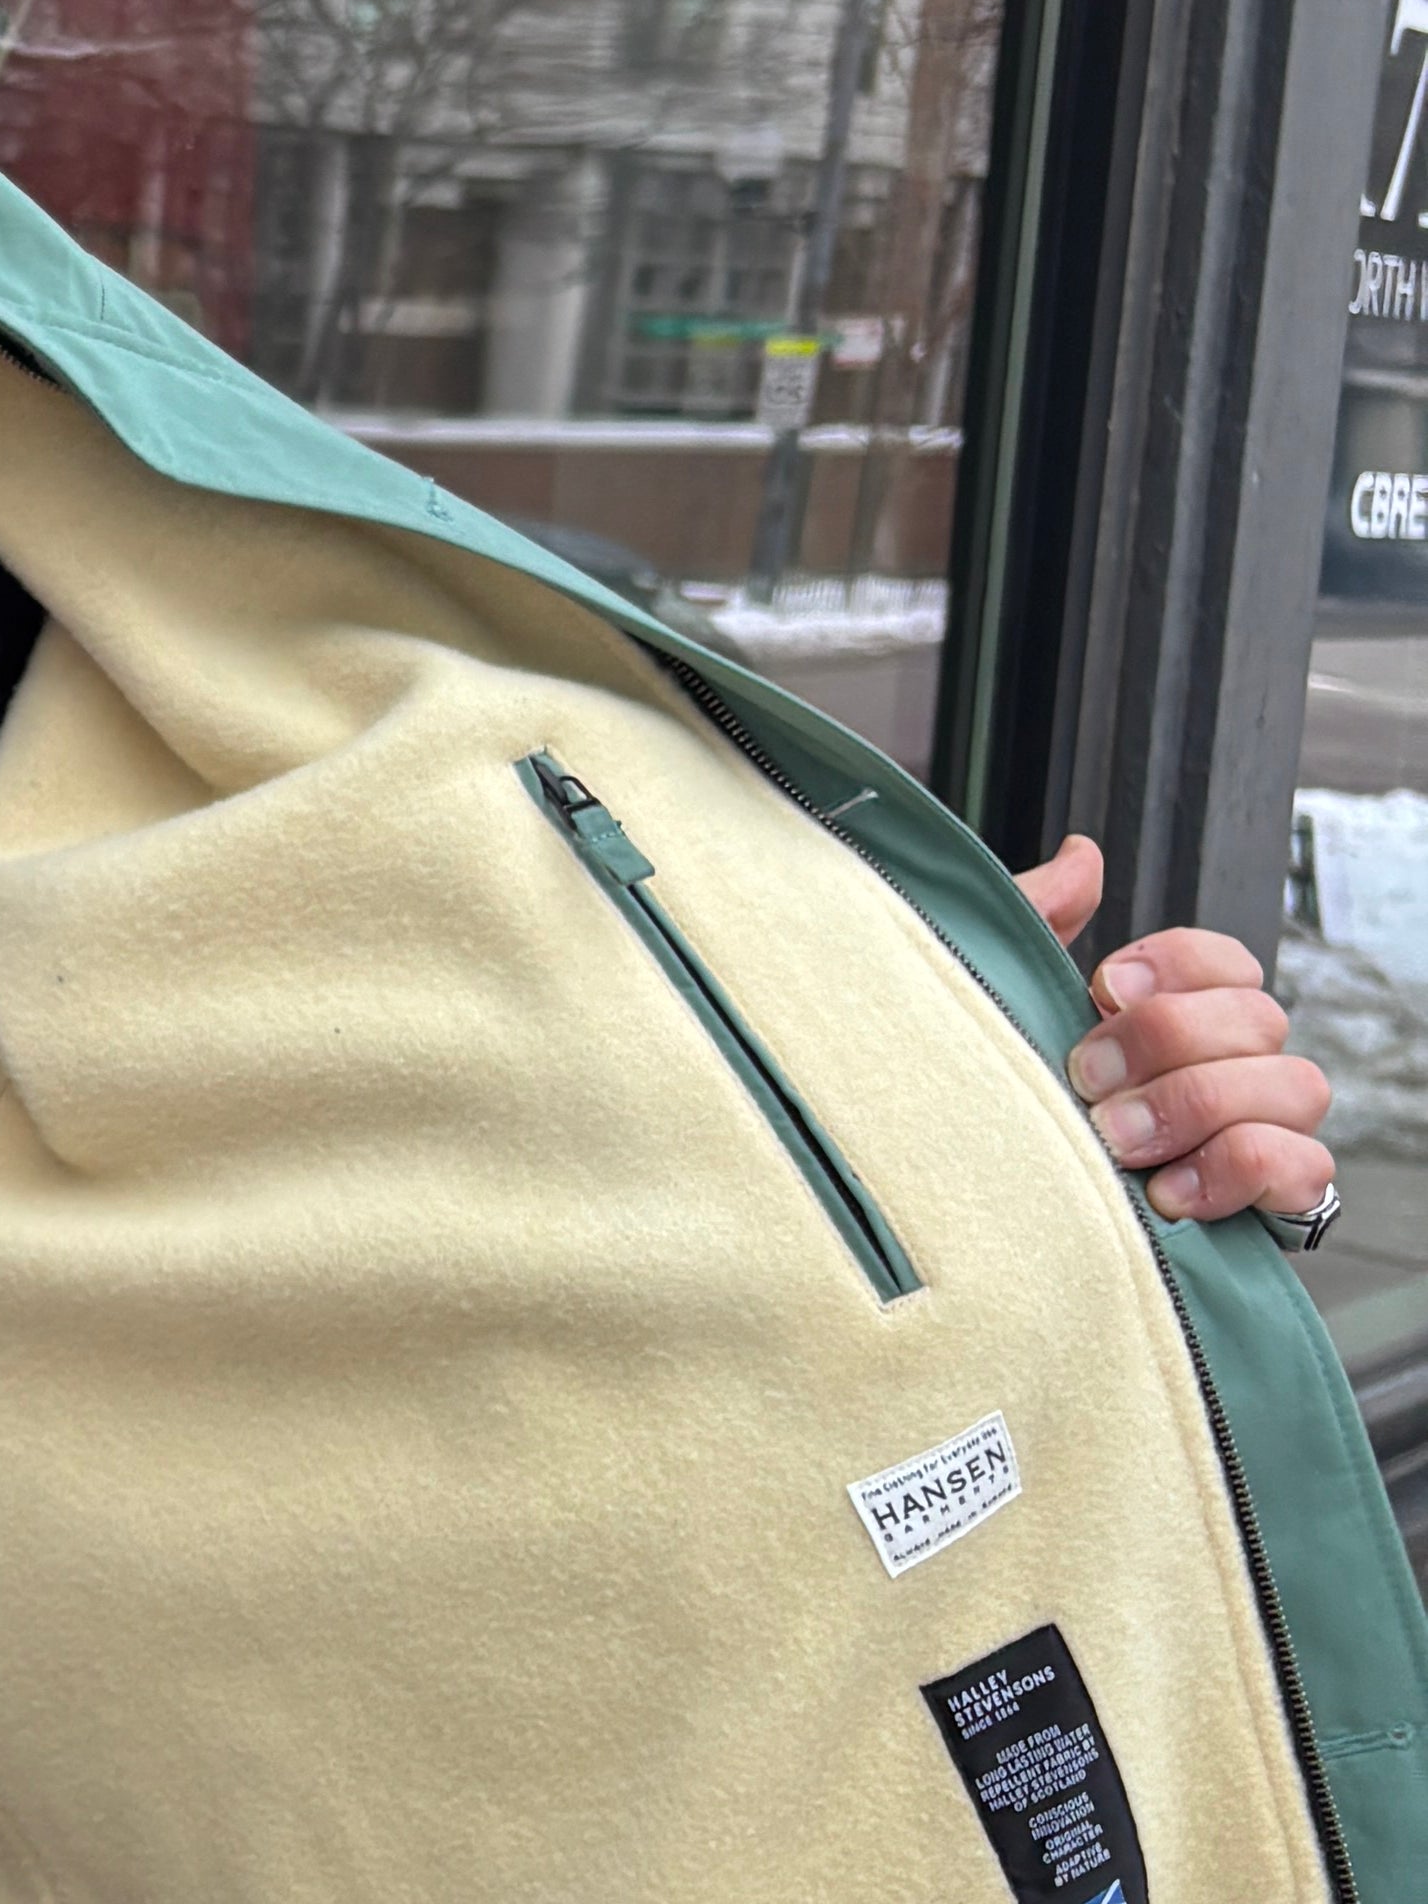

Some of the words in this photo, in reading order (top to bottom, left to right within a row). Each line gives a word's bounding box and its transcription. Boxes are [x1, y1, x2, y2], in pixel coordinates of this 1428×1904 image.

[871, 1440, 1007, 1530] HANSEN
[947, 1669, 1008, 1713] HALLEY
[954, 1665, 1056, 1727] STEVENSONS
[961, 1717, 993, 1741] SINCE
[996, 1740, 1028, 1764] MADE
[1027, 1724, 1062, 1747] FROM
[975, 1766, 1008, 1790] LONG
[1007, 1744, 1054, 1773] LASTING
[1053, 1723, 1092, 1751] WATER
[980, 1765, 1042, 1802] REPELLENT
[1042, 1745, 1082, 1771] FABRIC
[1082, 1736, 1096, 1751] BY
[989, 1783, 1030, 1812] HALLEY
[1031, 1747, 1099, 1790] STEVENSONS
[1013, 1796, 1029, 1812] OF
[1031, 1769, 1087, 1803] SCOTLAND
[1028, 1791, 1090, 1828] CONSCIOUS
[1031, 1801, 1095, 1841] INNOVATION
[1042, 1824, 1104, 1864] CHARACTER
[1045, 1820, 1093, 1850] ORIGINAL
[1071, 1848, 1112, 1880] NATURE
